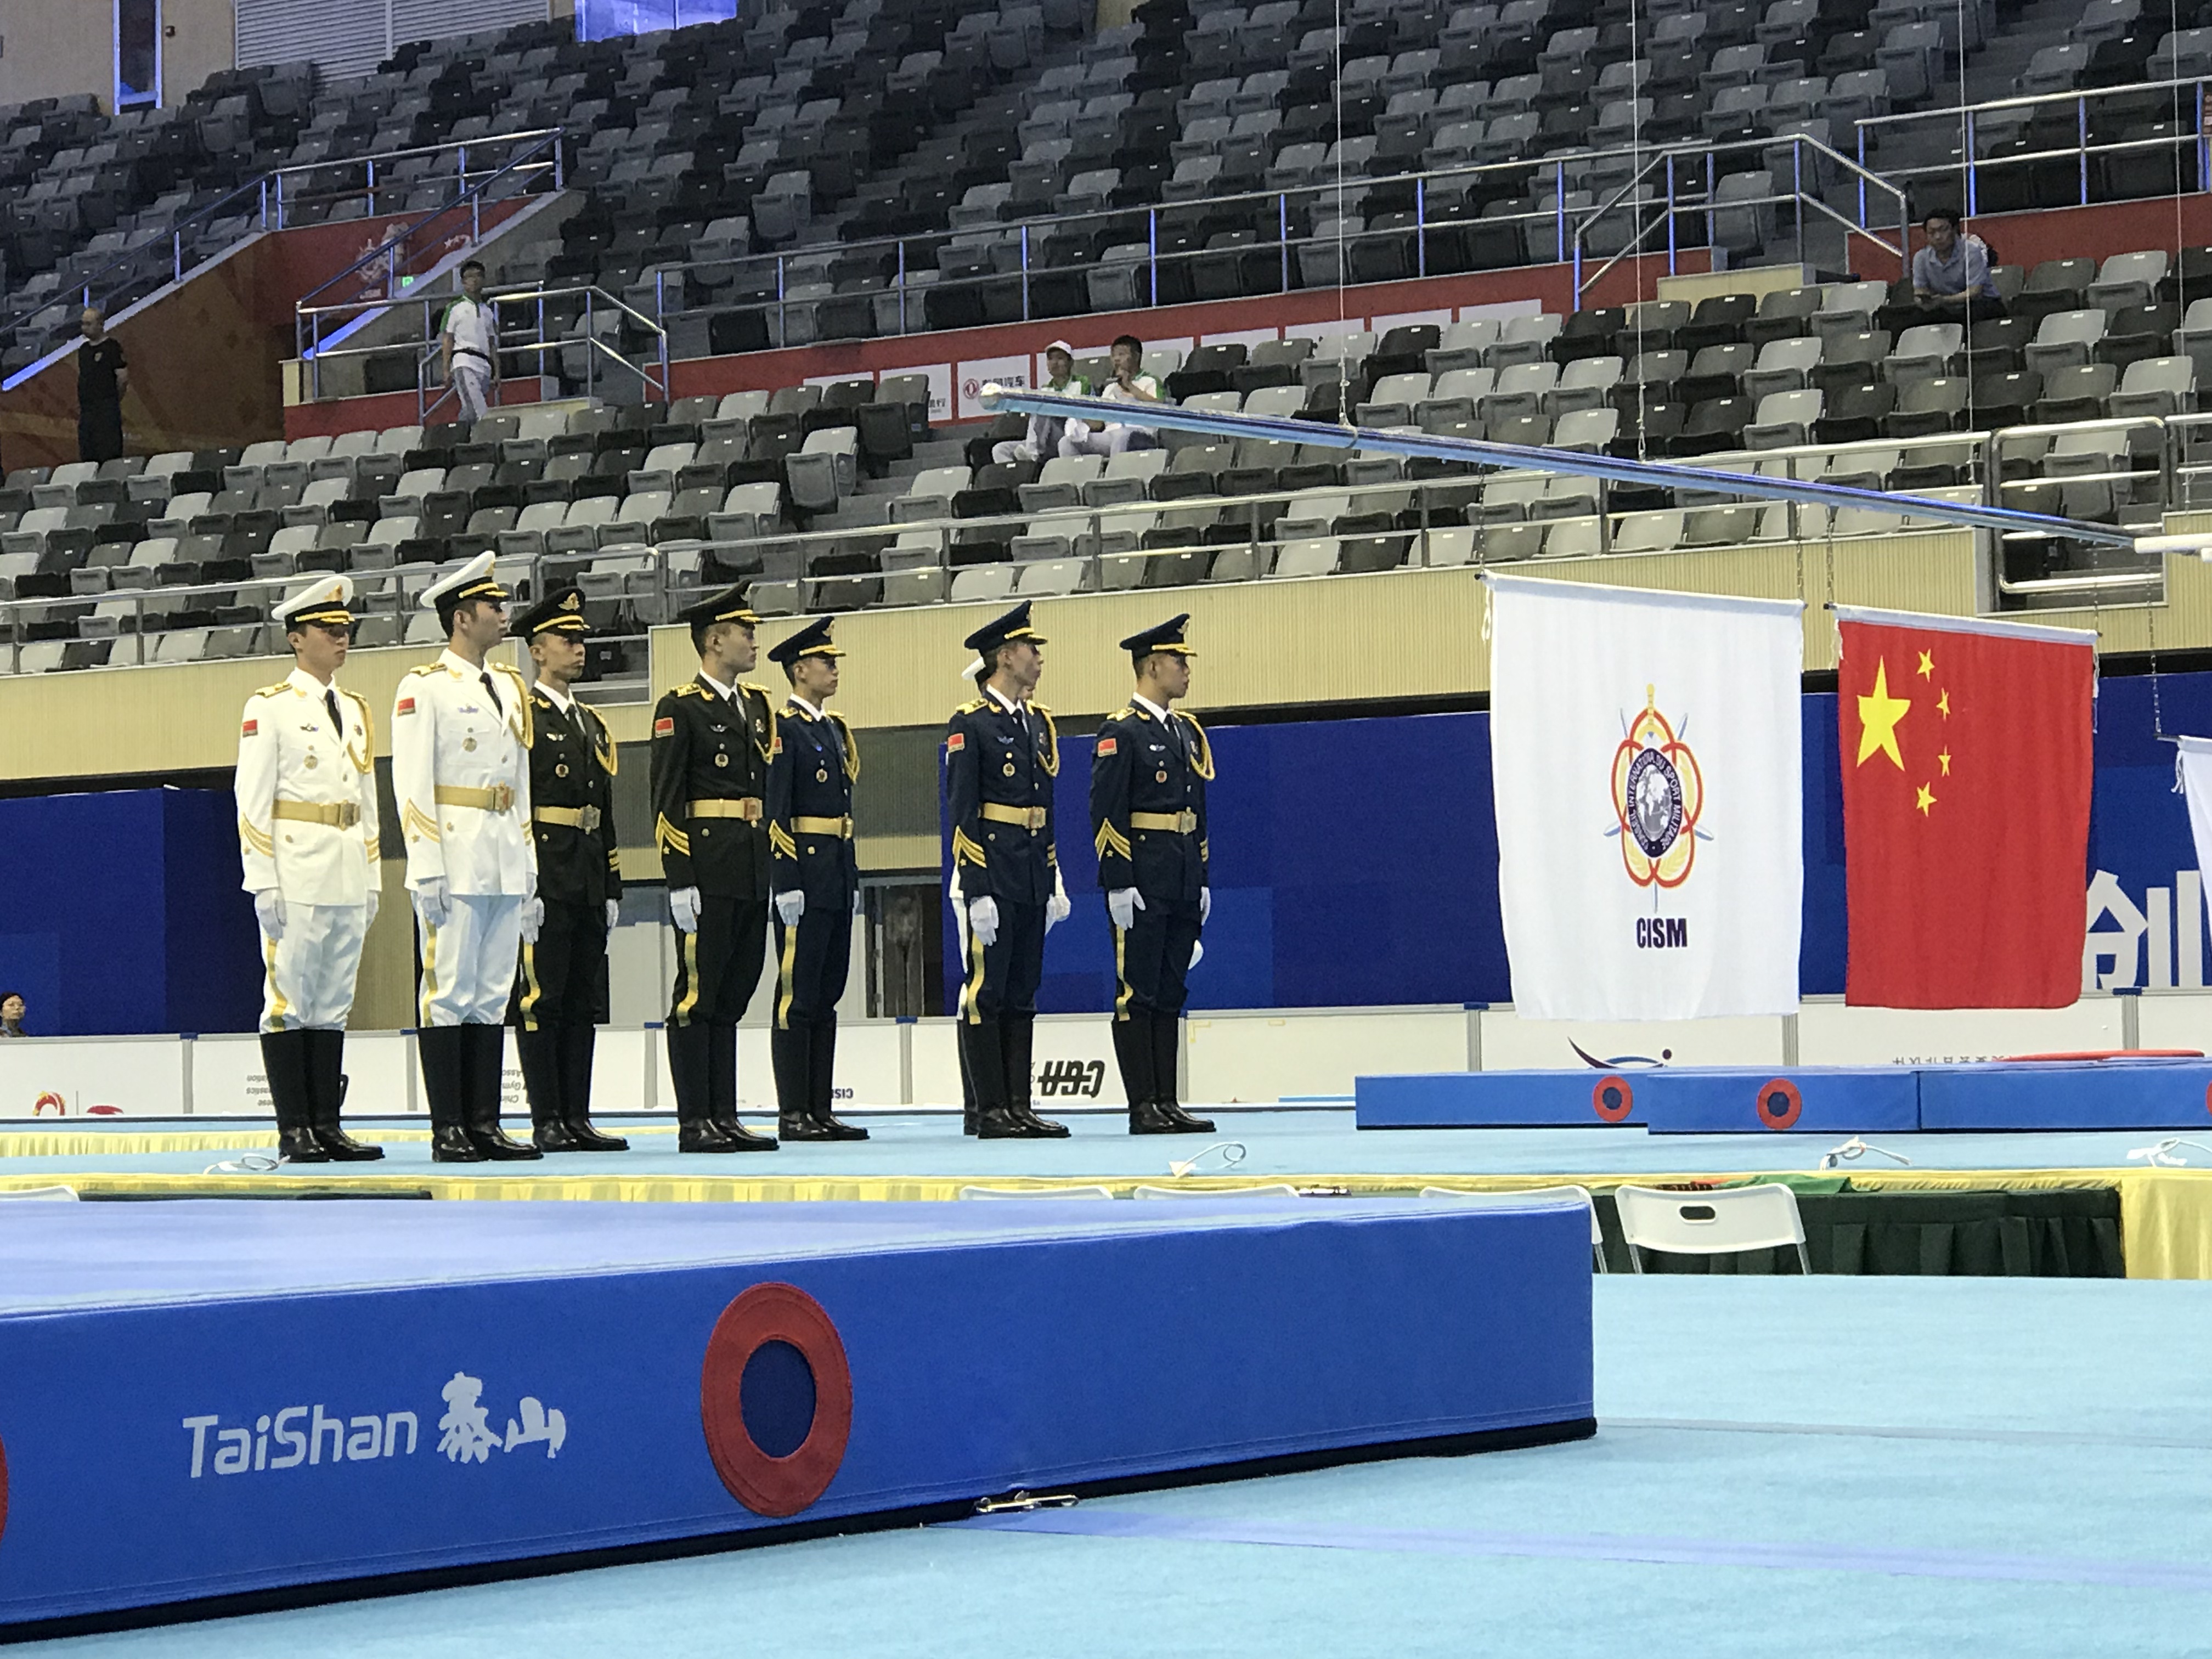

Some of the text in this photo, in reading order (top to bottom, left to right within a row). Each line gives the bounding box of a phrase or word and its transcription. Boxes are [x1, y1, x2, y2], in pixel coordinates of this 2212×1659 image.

[1663, 765, 1681, 801] SPORT
[1636, 917, 1688, 949] CISM
[183, 1404, 418, 1478] TaiShan
